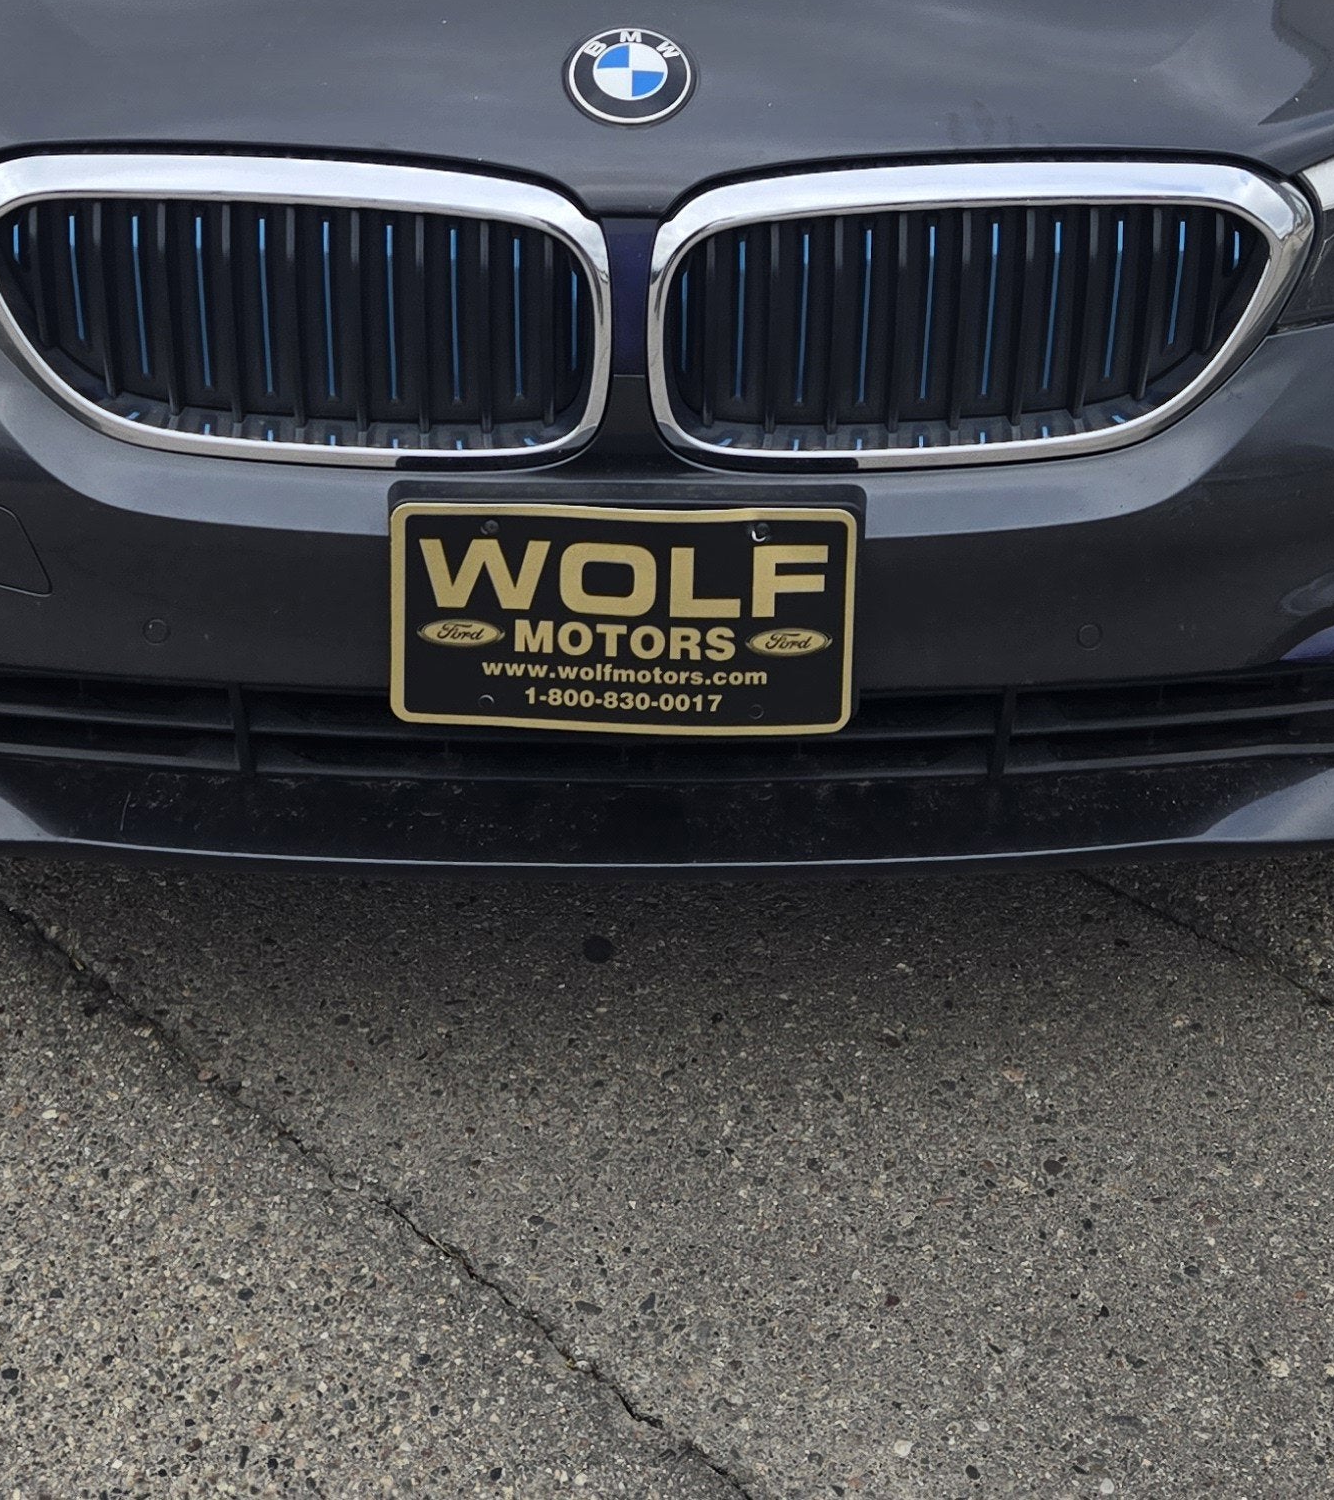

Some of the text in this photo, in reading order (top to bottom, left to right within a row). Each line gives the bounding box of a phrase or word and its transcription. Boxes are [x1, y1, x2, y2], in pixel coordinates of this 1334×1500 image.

[583, 30, 681, 58] BMW
[418, 537, 829, 618] WOLF
[436, 623, 484, 643] Ford
[513, 618, 737, 662] MOTORS
[764, 632, 812, 651] Ford
[482, 660, 768, 686] www.wolfmotors.com
[524, 686, 724, 713] 1-800-830-0017
